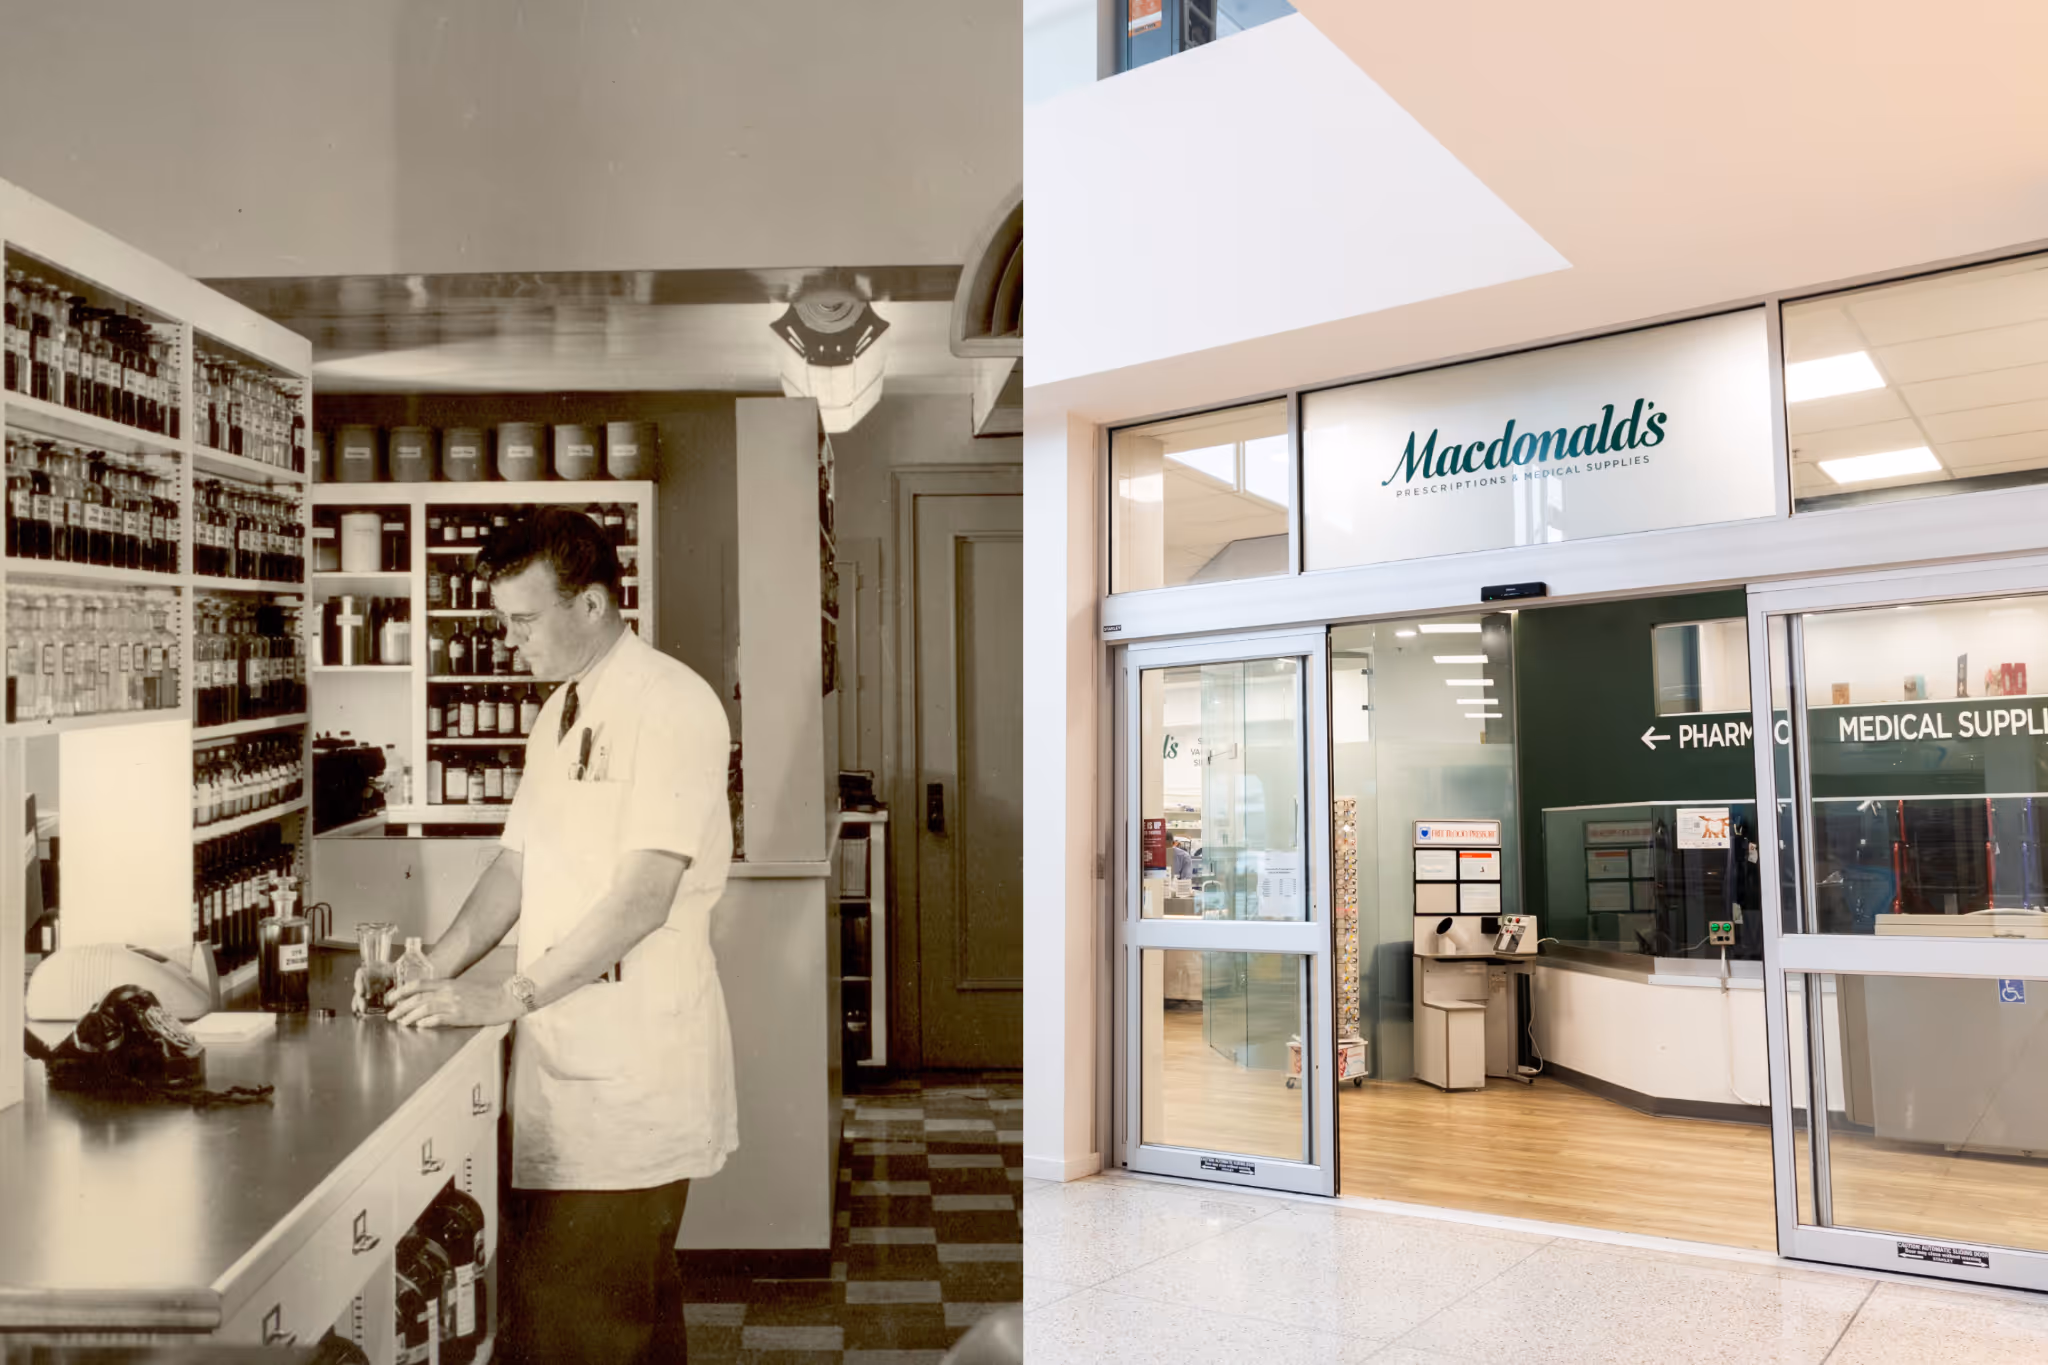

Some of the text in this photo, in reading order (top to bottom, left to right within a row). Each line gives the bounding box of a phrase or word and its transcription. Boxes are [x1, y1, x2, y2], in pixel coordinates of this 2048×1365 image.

[1381, 397, 1668, 487] Macdonald's
[1395, 475, 1507, 498] PRESCRIPTIONS
[1523, 466, 1581, 482] MEDICAL
[1586, 454, 1651, 473] SUPPLIES
[1678, 720, 1791, 749] PHARMC
[1838, 712, 1953, 743] MEDICAL
[1921, 1245, 1951, 1254] AUTOMATIC
